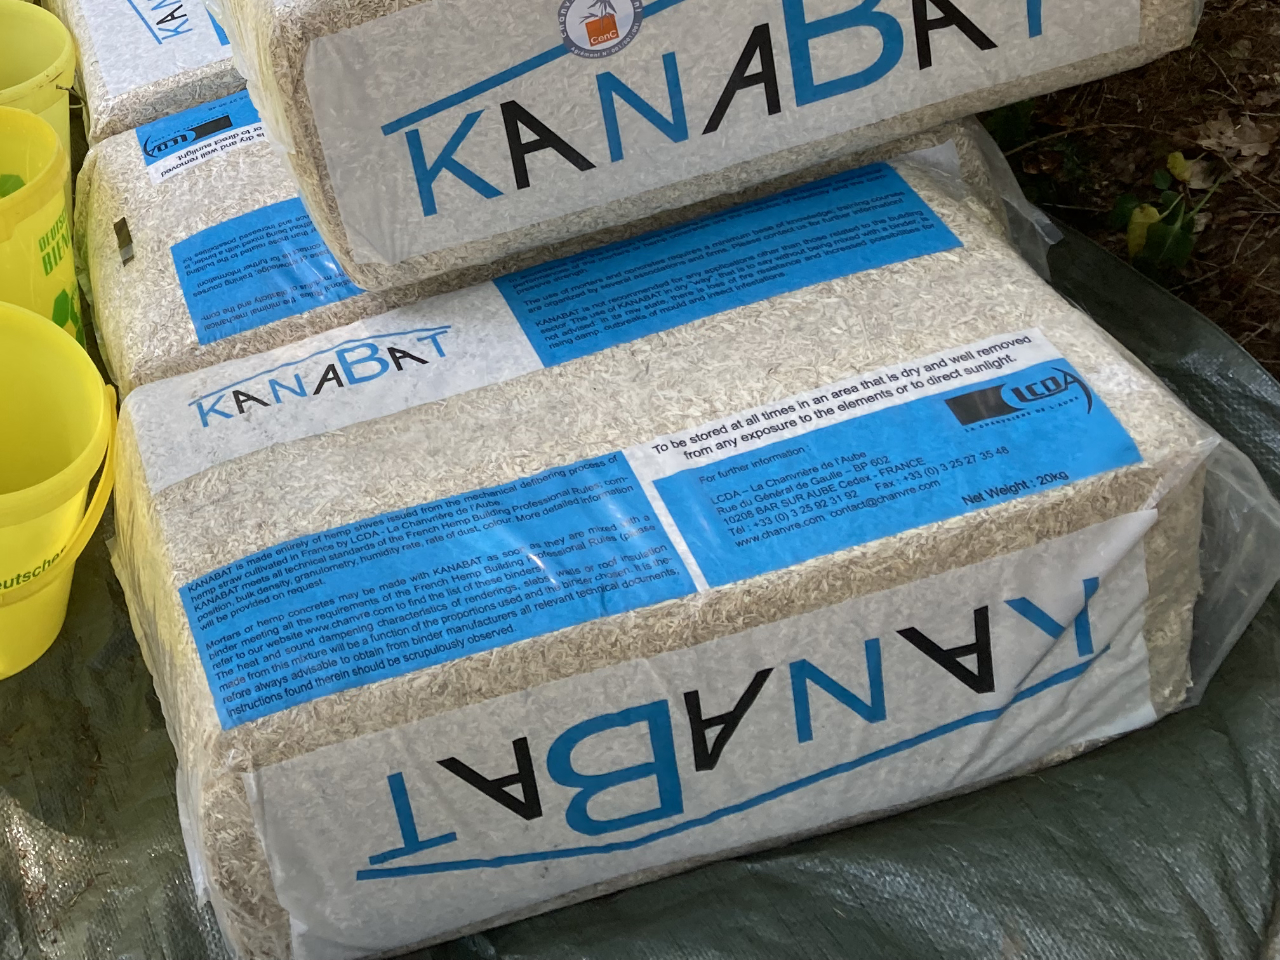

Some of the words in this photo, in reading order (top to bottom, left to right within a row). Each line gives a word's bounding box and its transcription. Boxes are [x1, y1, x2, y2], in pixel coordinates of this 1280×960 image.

[590, 30, 618, 45] CenC
[213, 131, 239, 146] direct
[219, 139, 236, 151] and
[239, 133, 254, 145] dry
[240, 128, 250, 136] to
[252, 125, 261, 133] or
[160, 155, 198, 177] removed
[200, 147, 218, 158] well
[197, 330, 449, 427] KANABAT
[652, 444, 669, 455] To
[670, 439, 687, 449] be
[689, 424, 728, 444] stored
[730, 418, 744, 430] at
[744, 413, 760, 425] all
[761, 404, 796, 420] times
[796, 400, 810, 409] in
[811, 394, 829, 405] an
[829, 384, 860, 399] area
[859, 375, 886, 389] that
[885, 372, 899, 382] is
[898, 366, 923, 378] dry
[922, 357, 948, 371] and
[948, 349, 975, 364] well
[975, 333, 1032, 356] removed
[1009, 370, 1082, 404] LCDA
[683, 446, 713, 460] from
[715, 437, 739, 450] any
[740, 419, 798, 441] exposure
[797, 414, 812, 423] to
[813, 407, 835, 419] the
[836, 389, 894, 412] elements
[894, 385, 909, 394] or
[909, 380, 925, 389] to
[925, 368, 962, 385] direct
[963, 354, 1017, 374] sunlight.
[698, 475, 717, 484] For
[716, 464, 749, 478] further
[750, 447, 805, 468] information
[709, 489, 741, 504] LCDA
[749, 483, 764, 492] La
[764, 466, 819, 487] Chanvrière
[819, 461, 834, 470] de
[833, 450, 867, 465] l'Aube
[715, 504, 738, 515] Rue
[738, 499, 753, 508] du
[753, 484, 795, 503] Général
[795, 481, 809, 490] de
[809, 470, 843, 486] Gaulle
[852, 461, 869, 472] BP
[869, 455, 890, 467] 602
[755, 501, 780, 515] BAR
[780, 493, 805, 507] SUR
[805, 483, 837, 499] AUBE
[837, 475, 872, 489] Cedex
[878, 456, 925, 477] FRANCE
[960, 491, 986, 505] Net
[984, 479, 1030, 498] Weight
[1035, 471, 1070, 485] 20kg
[727, 524, 746, 536] Tél
[753, 516, 773, 528] +33
[773, 512, 790, 523] (0)
[789, 508, 798, 517] 3
[798, 503, 814, 514] 25
[813, 498, 829, 509] 92
[828, 494, 842, 505] 31
[843, 488, 859, 500] 92
[874, 480, 895, 490] Fax
[902, 469, 922, 482] +33
[922, 466, 940, 477] (0)
[938, 462, 948, 471] 3
[948, 458, 964, 468] 25
[963, 453, 978, 464] 27
[978, 449, 994, 460] 35
[993, 444, 1010, 455] 48
[735, 515, 825, 547] www.chanvre.com
[829, 480, 941, 518] contact@chanvre.com
[190, 587, 217, 602] hemp
[217, 575, 243, 589] straw
[244, 556, 288, 577] cultivated
[301, 544, 334, 557] France
[336, 540, 348, 548] by
[349, 530, 379, 544] LCDA
[400, 512, 454, 529] Chanvrière
[227, 693, 282, 717] instructions
[284, 681, 313, 696] found
[314, 671, 350, 687] therein
[351, 660, 385, 675] should
[386, 657, 401, 666] be
[402, 639, 467, 662] scrupulously
[467, 624, 517, 643] observed.
[368, 577, 1099, 865] KANABAT
